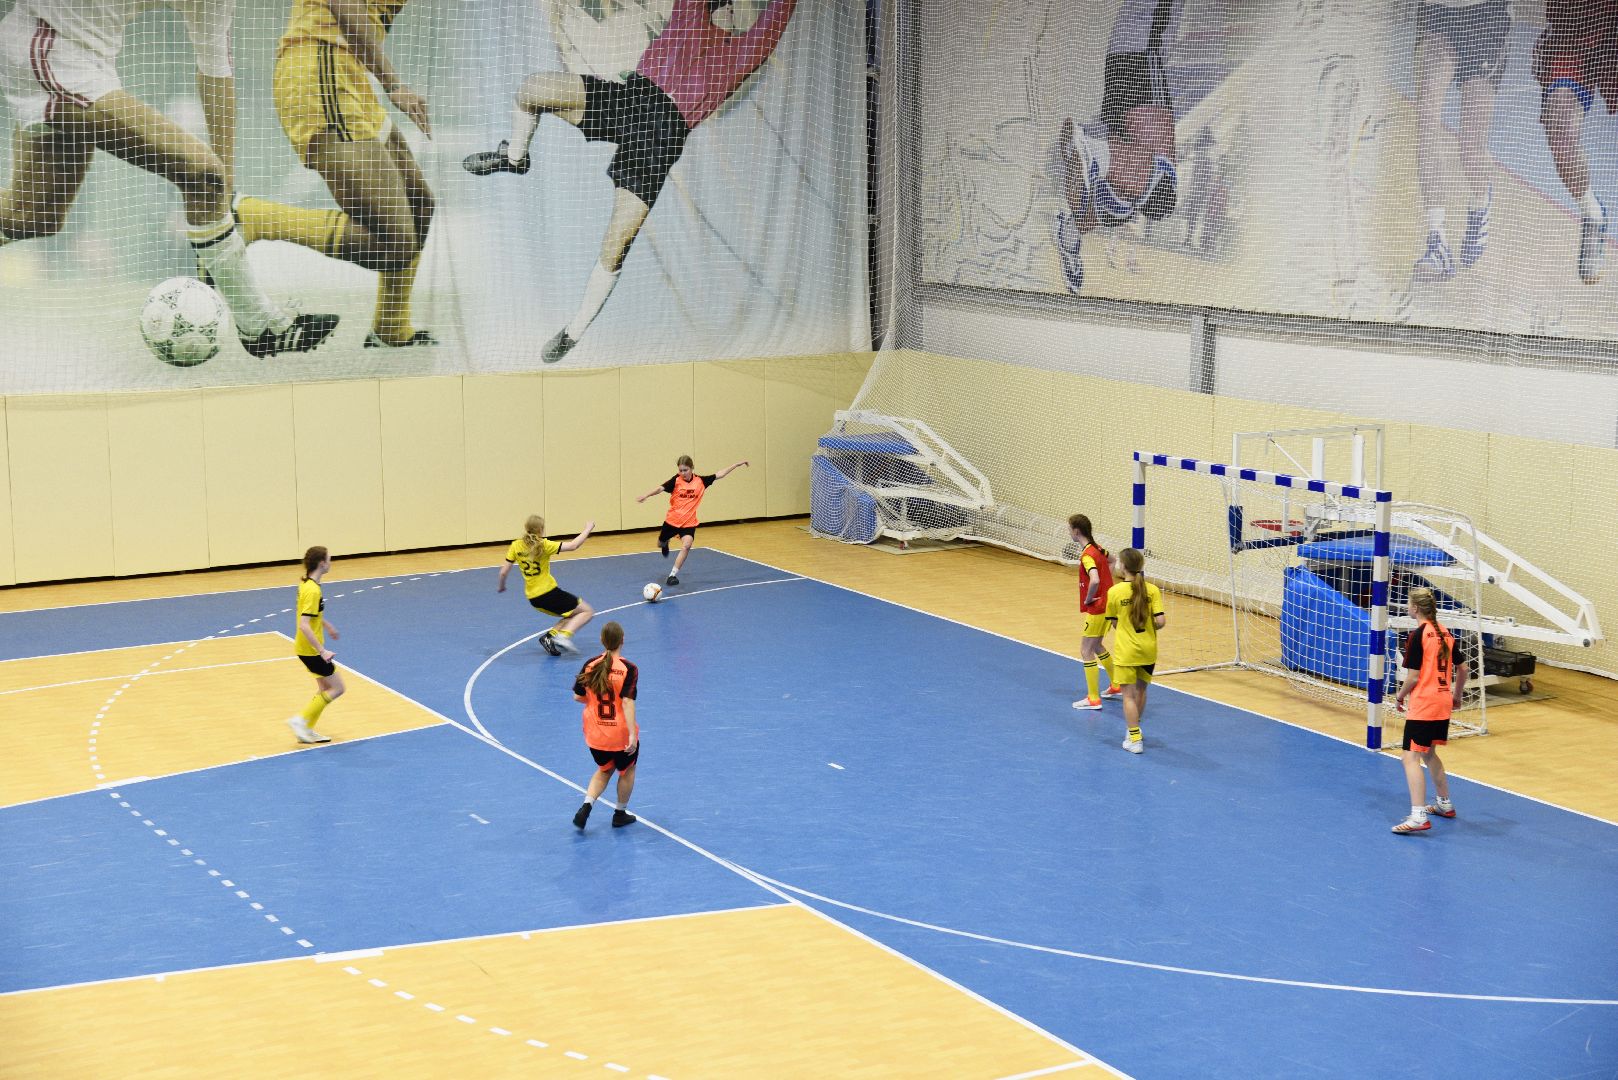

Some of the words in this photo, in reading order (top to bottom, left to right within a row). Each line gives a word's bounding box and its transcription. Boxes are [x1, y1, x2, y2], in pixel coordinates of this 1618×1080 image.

[521, 560, 541, 577] 23
[1437, 654, 1449, 686] 9
[597, 687, 616, 720] 8
